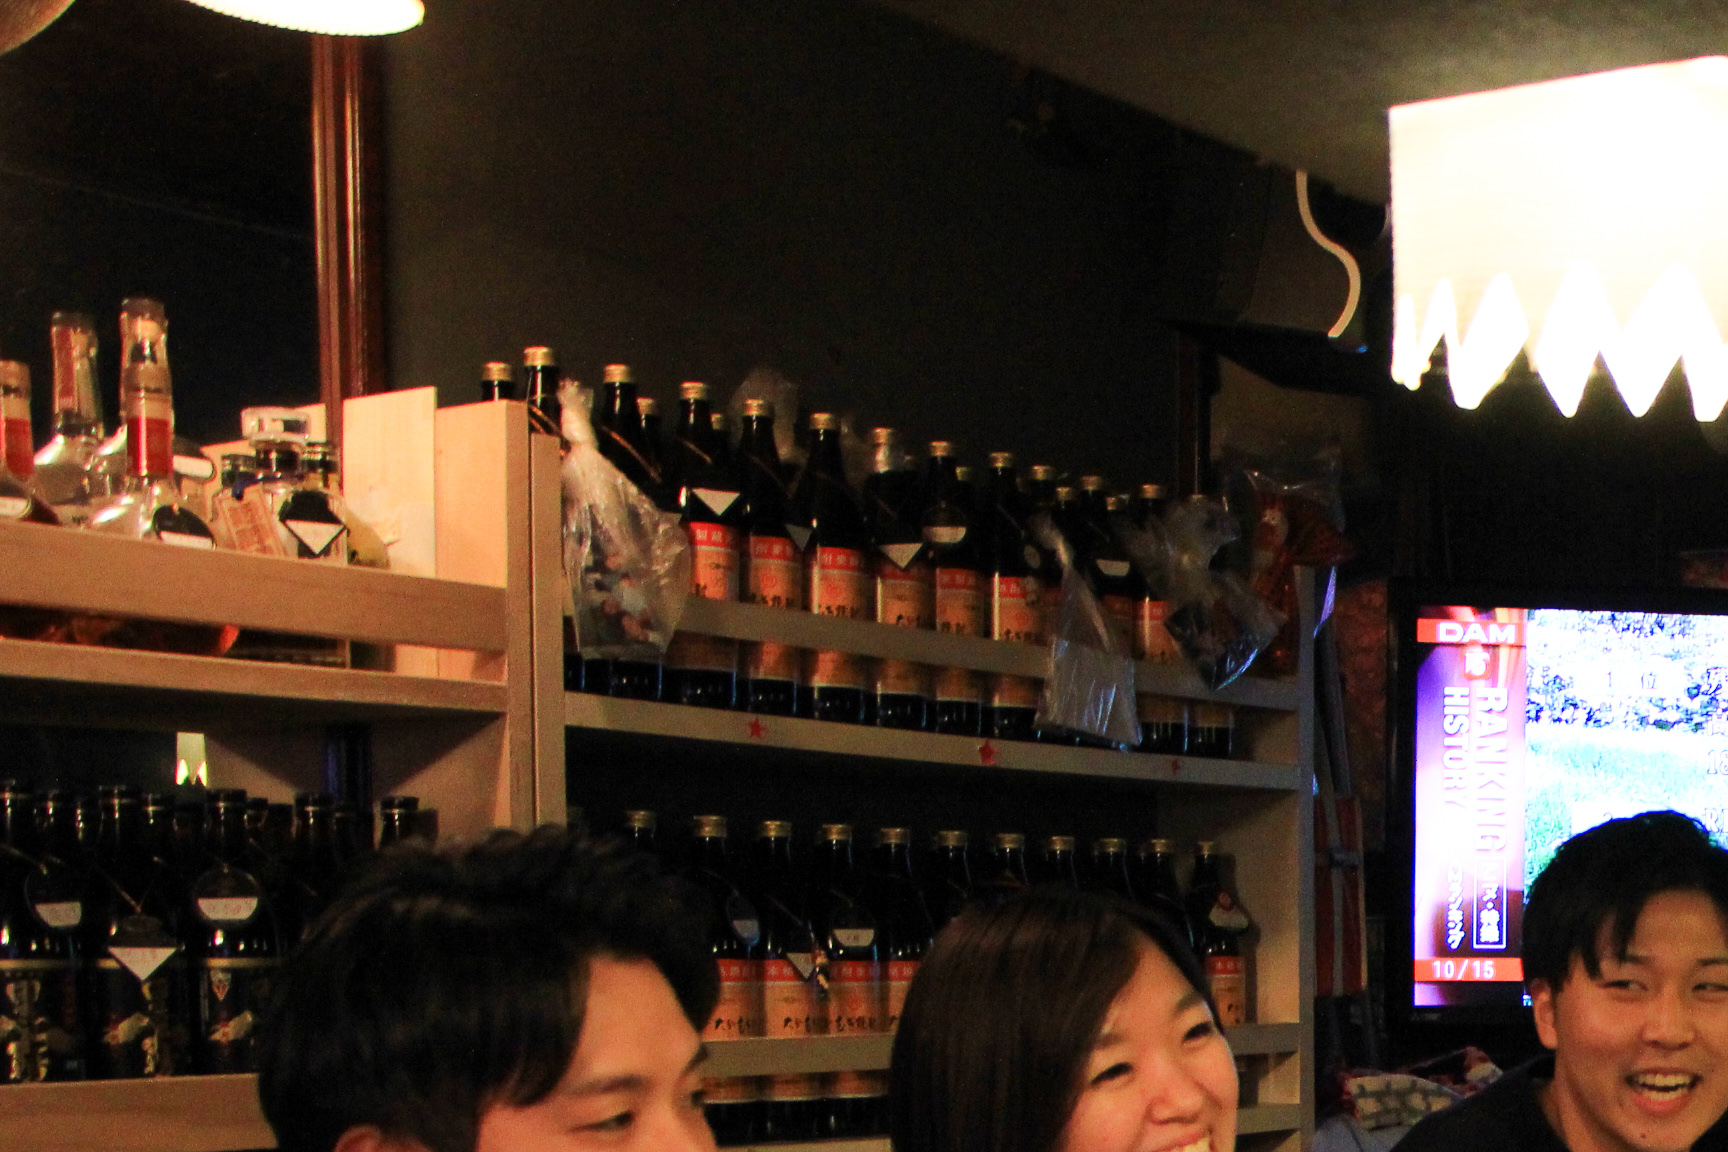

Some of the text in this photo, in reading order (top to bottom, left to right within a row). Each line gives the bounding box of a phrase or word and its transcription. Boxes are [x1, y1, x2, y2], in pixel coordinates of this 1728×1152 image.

[1437, 621, 1516, 645] DAM
[1443, 686, 1471, 810] HISTORY
[1475, 687, 1509, 853] RANKING
[1432, 958, 1496, 981] 10/15
